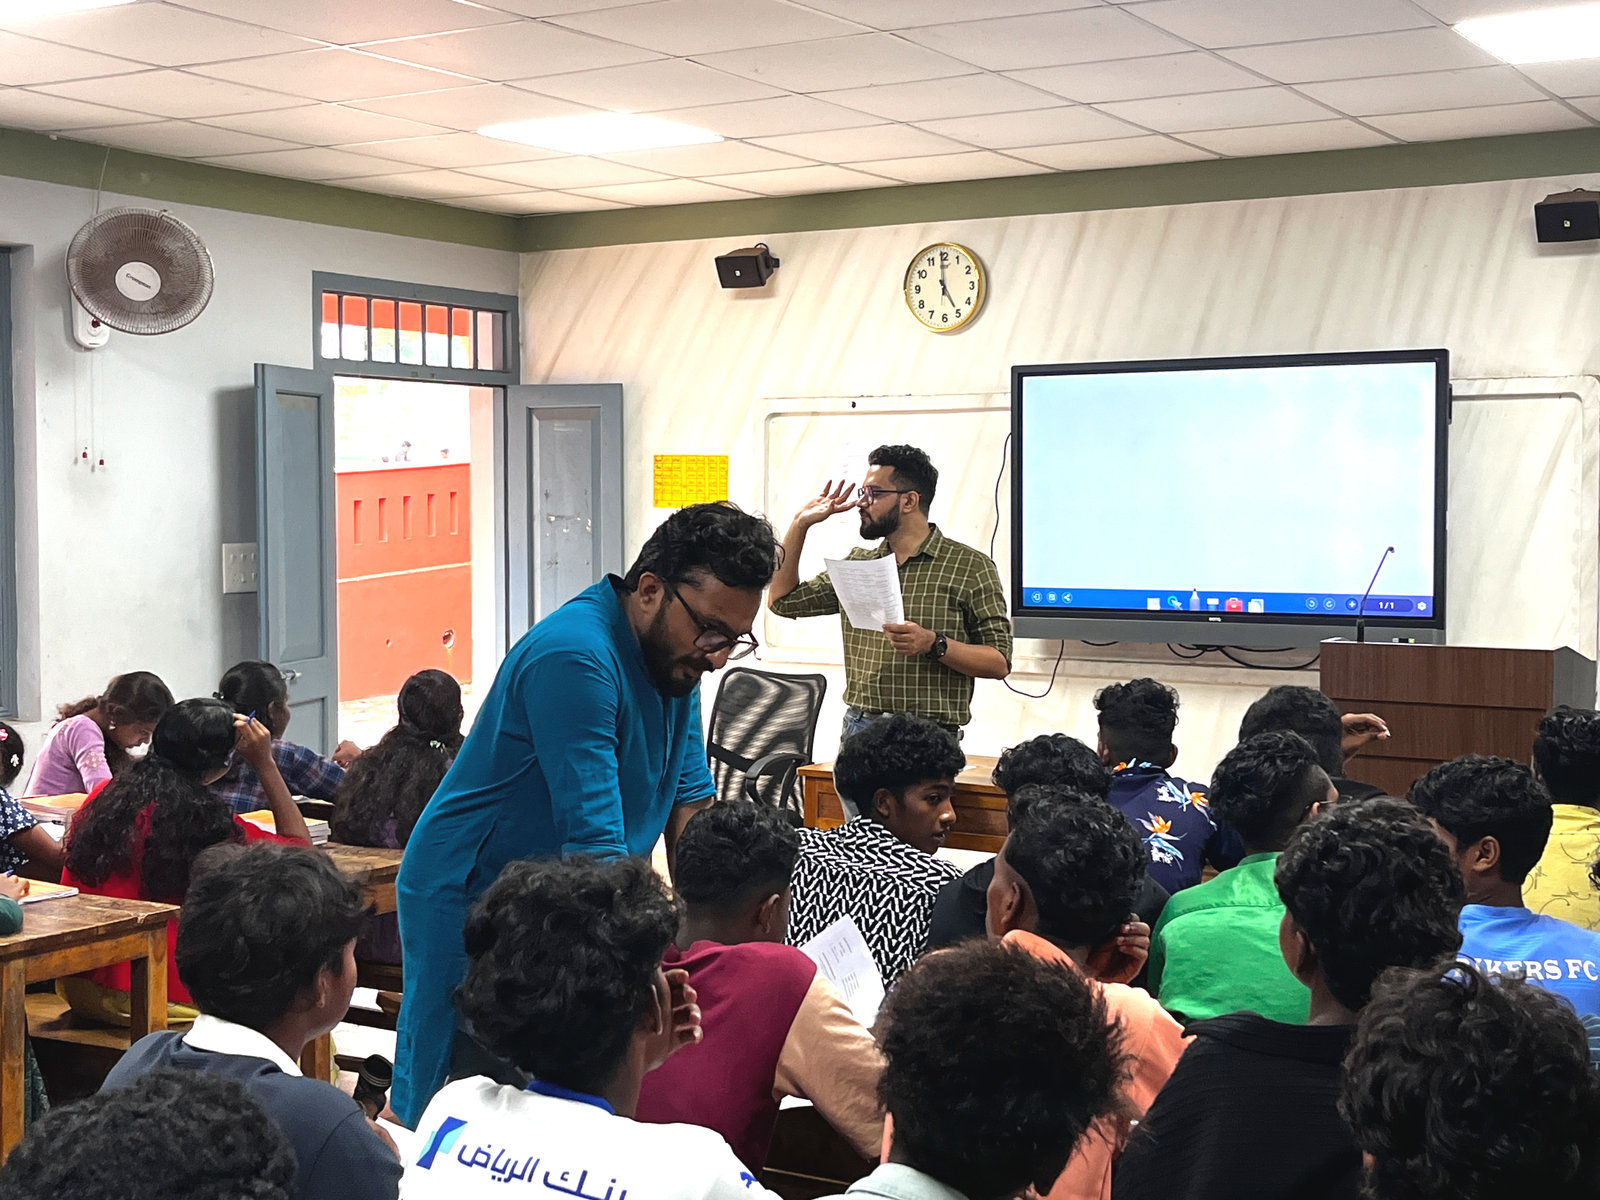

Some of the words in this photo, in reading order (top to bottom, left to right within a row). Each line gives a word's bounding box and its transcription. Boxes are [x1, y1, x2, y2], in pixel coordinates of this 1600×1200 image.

[927, 257, 935, 267] 11
[940, 252, 949, 262] 12
[955, 255, 960, 265] 1
[917, 269, 927, 279] 10
[965, 265, 972, 275] 2
[915, 285, 921, 294] 9
[969, 281, 975, 291] 3
[918, 300, 925, 309] 8
[965, 297, 971, 306] 4
[928, 310, 935, 319] 7
[942, 314, 948, 323] 6
[955, 309, 961, 318] 5
[1378, 601, 1394, 610] 1/1
[1564, 958, 1599, 982] FC
[457, 1143, 541, 1184] الرياض
